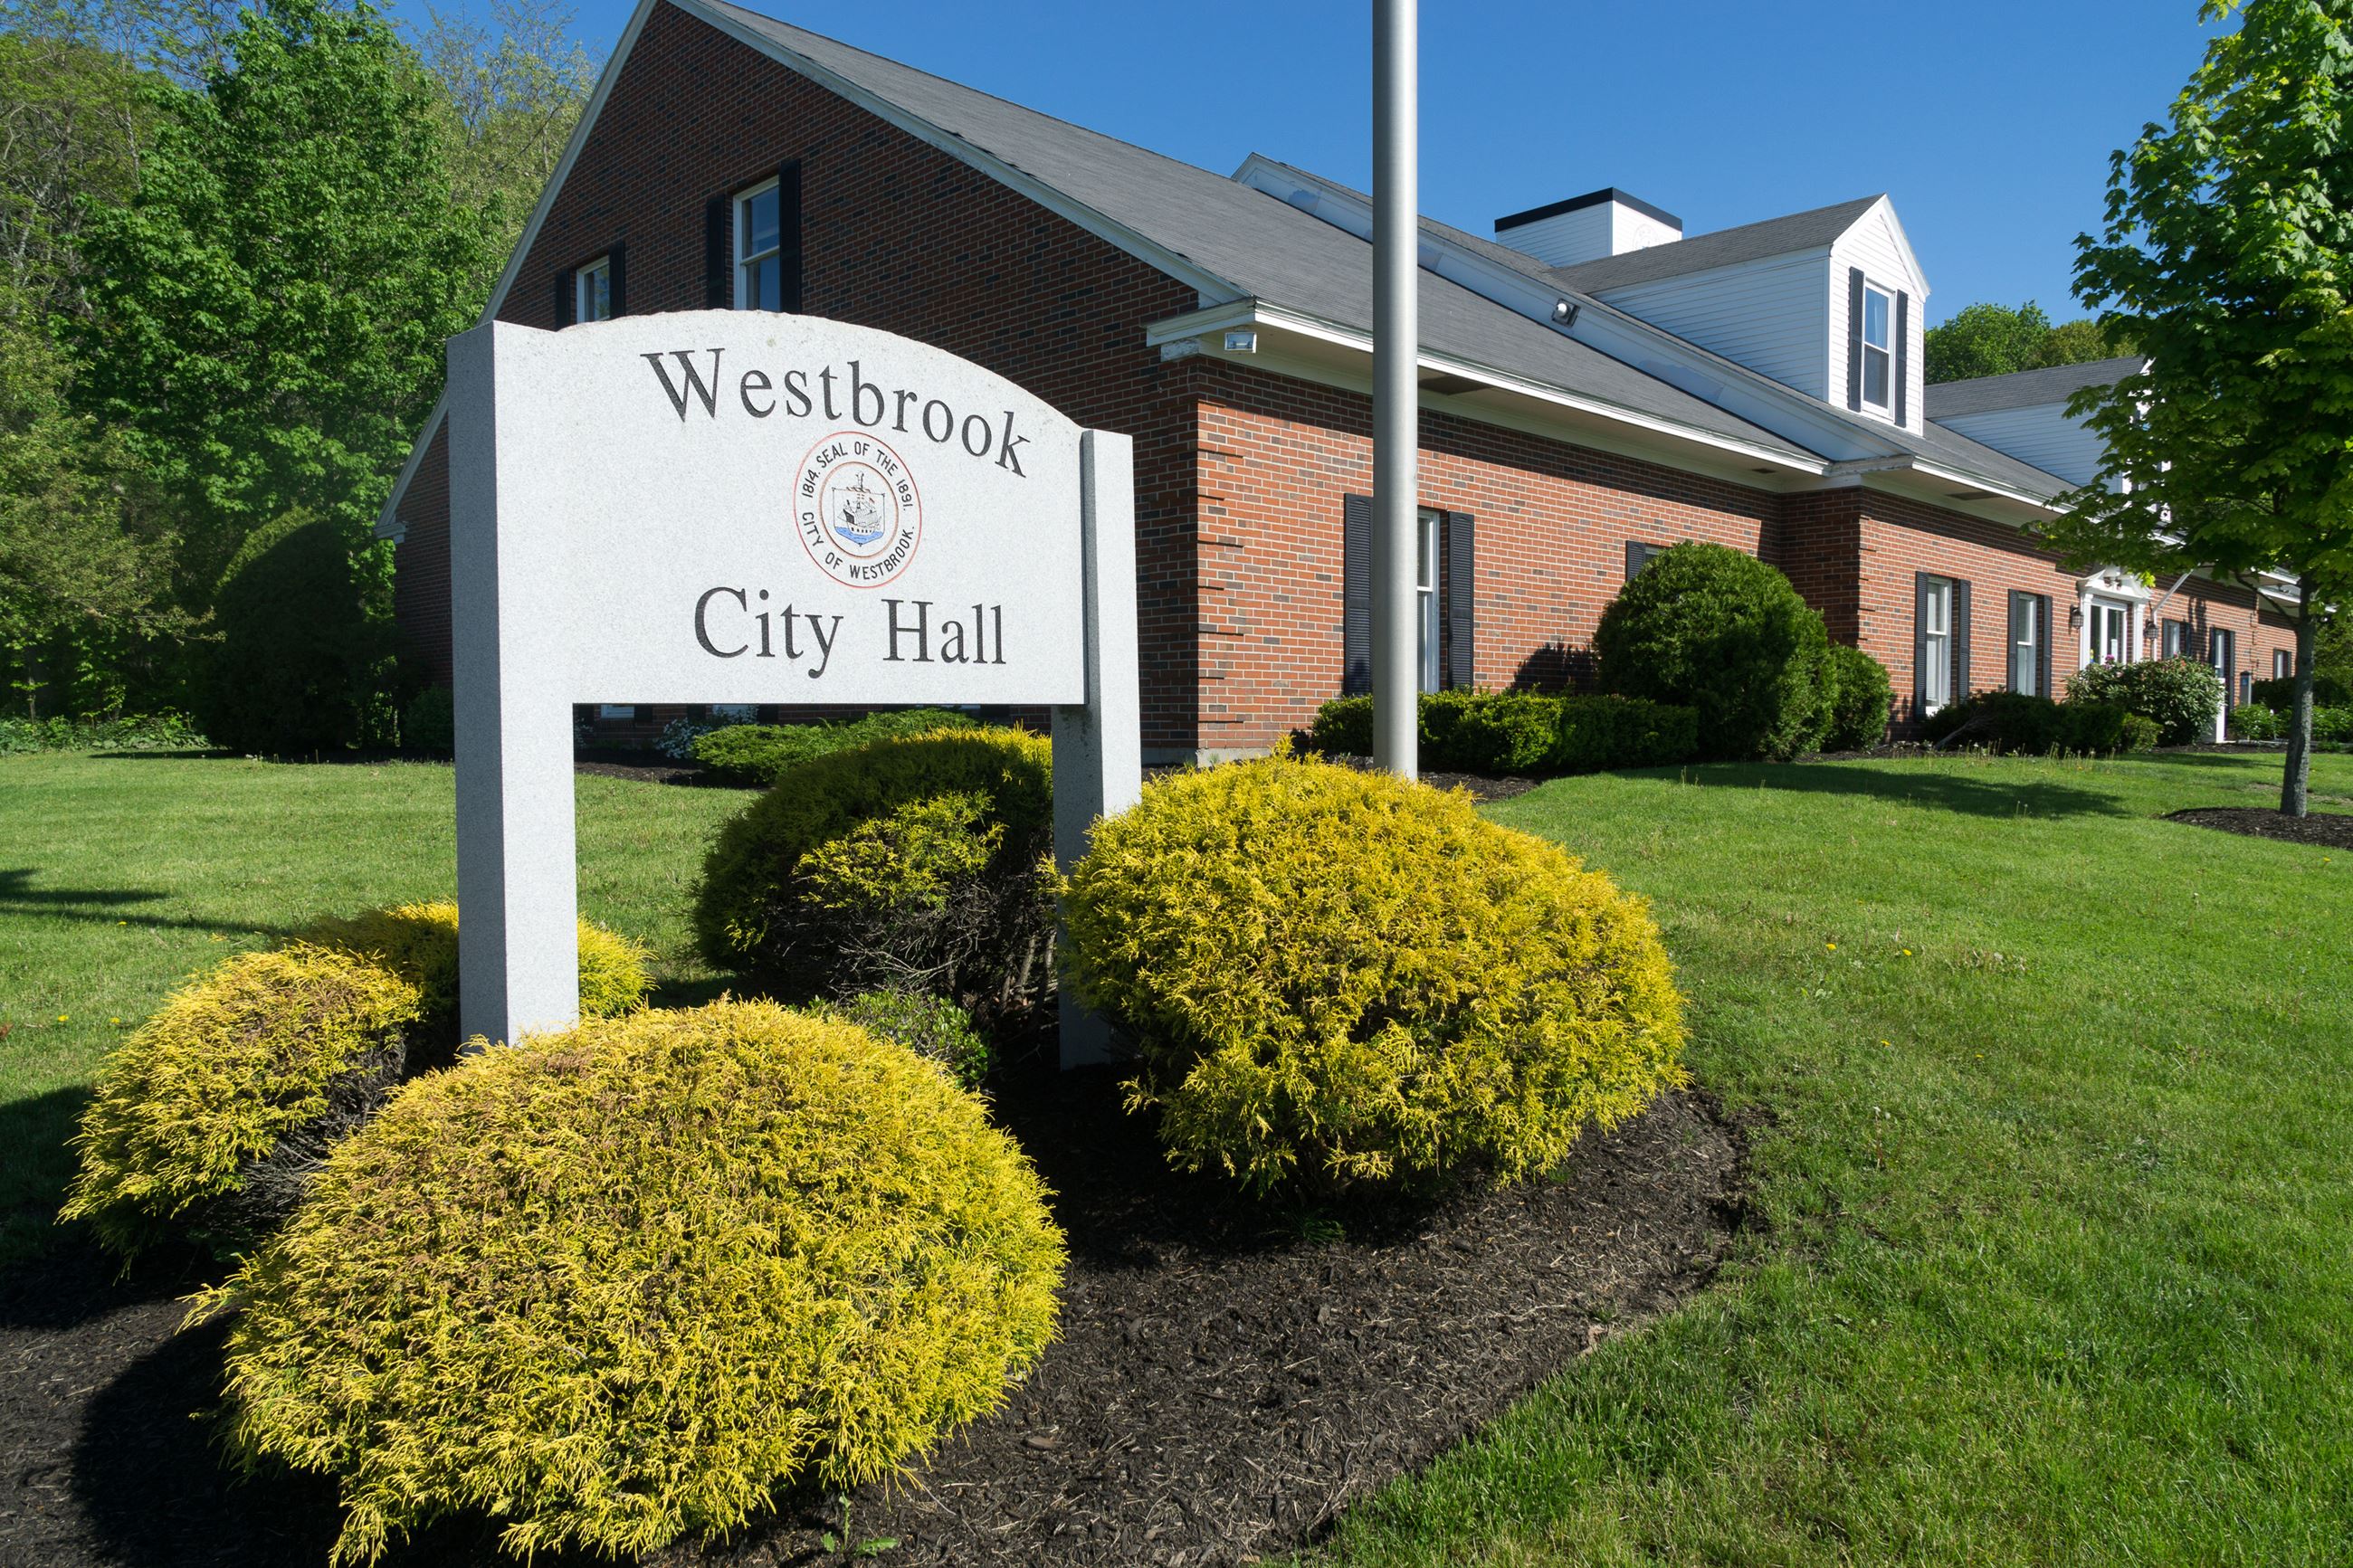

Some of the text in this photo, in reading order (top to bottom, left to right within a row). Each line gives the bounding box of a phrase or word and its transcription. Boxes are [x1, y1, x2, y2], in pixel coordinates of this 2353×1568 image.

[639, 347, 1031, 479] Westbrook
[816, 441, 899, 477] SEAL OF THE
[802, 511, 824, 546] CITY
[824, 552, 843, 570] OF
[694, 586, 1007, 679] City Hall
